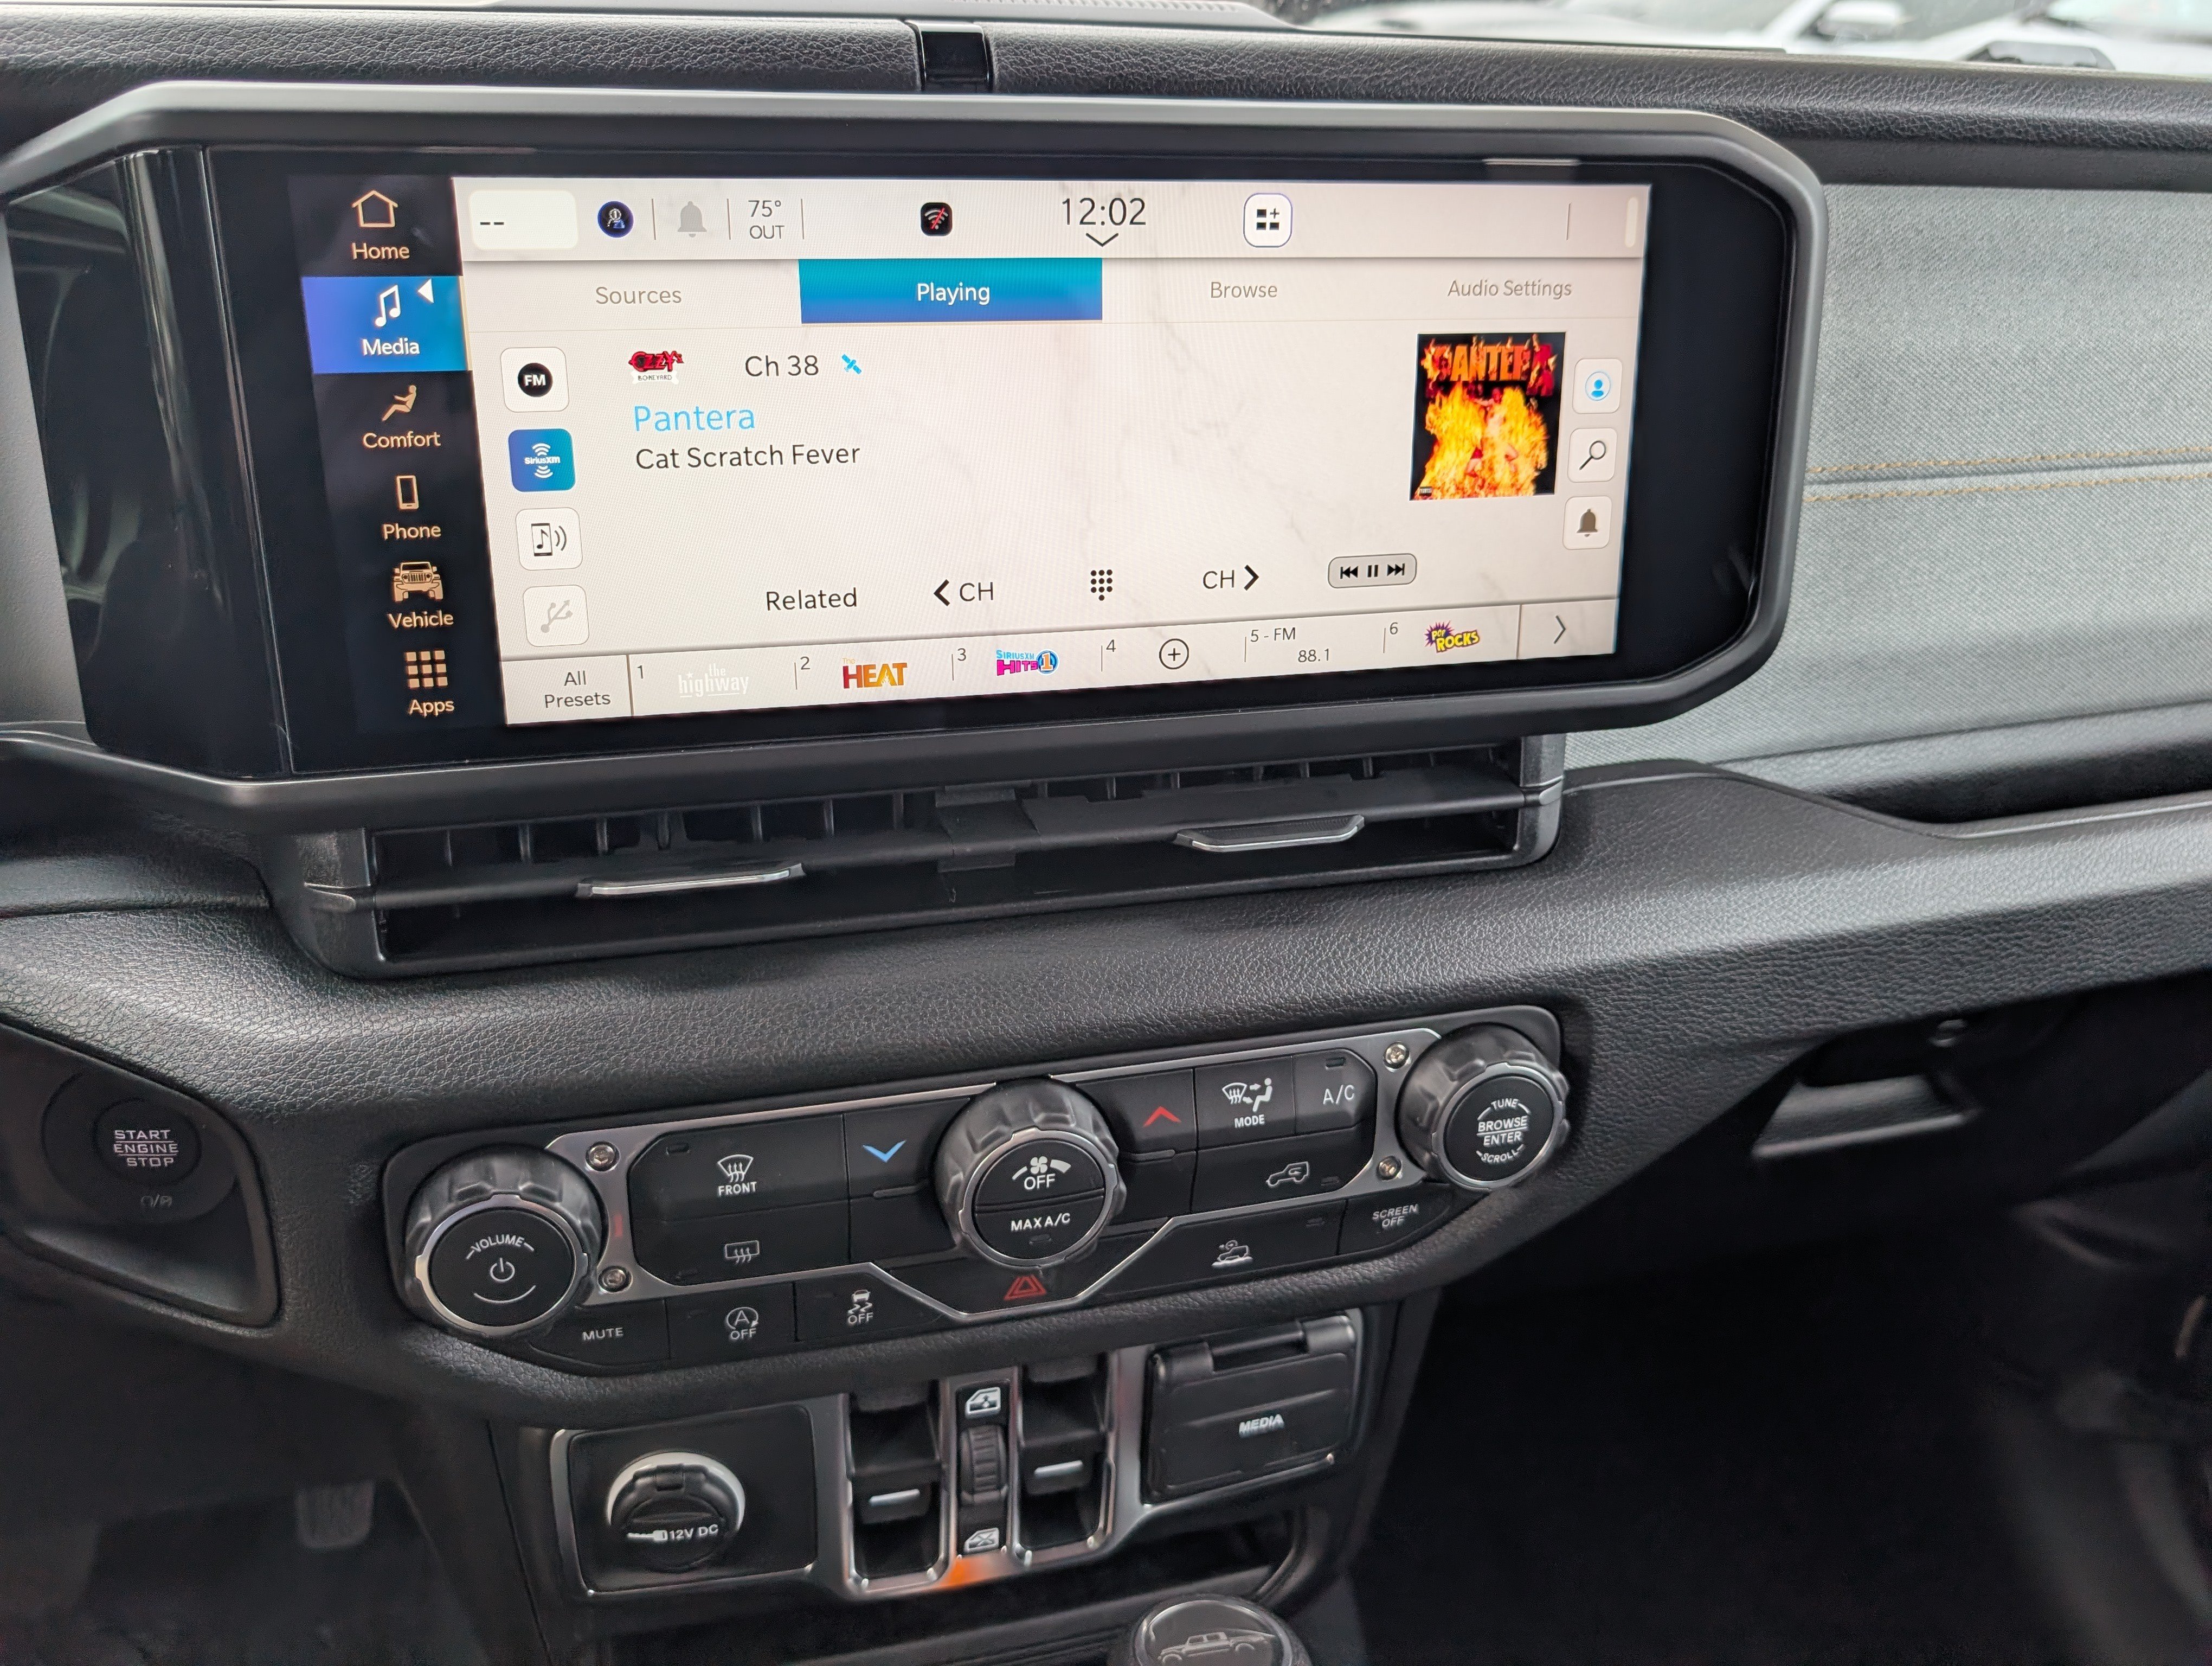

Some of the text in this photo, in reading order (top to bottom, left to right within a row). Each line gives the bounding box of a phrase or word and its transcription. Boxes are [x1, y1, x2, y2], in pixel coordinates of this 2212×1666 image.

[1061, 197, 1147, 226] 12:02
[749, 225, 785, 240] OUT
[351, 242, 410, 260] Home
[595, 286, 683, 305] Sources
[916, 282, 991, 305] Playing
[1210, 281, 1278, 299] Browse
[1447, 278, 1572, 300] Audio Settings
[362, 338, 420, 356] Media
[745, 356, 819, 376] Ch 38
[524, 374, 546, 387] FM
[634, 406, 756, 432] Pantera
[363, 431, 441, 449] Comfort
[636, 444, 861, 469] Cat Scratch Fever
[382, 523, 442, 540] Phone
[1203, 569, 1235, 589] CH
[766, 587, 858, 611] Related
[959, 581, 994, 602] CH
[387, 610, 454, 629] Vehicle
[1250, 630, 1259, 642] 5
[1273, 627, 1296, 641] FM
[1389, 622, 1398, 635] 6
[1105, 639, 1116, 652] 4
[1436, 631, 1480, 652] ROCKS
[957, 648, 967, 661] 3
[1297, 648, 1330, 663] 88.1
[709, 663, 726, 677] the
[800, 657, 811, 670] 2
[996, 653, 1053, 676] HITS 1
[564, 670, 588, 686] All
[637, 665, 645, 680] 1
[843, 662, 908, 689] HEAT
[678, 671, 749, 697] highway
[408, 699, 455, 717] Apps
[545, 691, 612, 708] Presets
[1322, 1084, 1355, 1105] A/C
[1491, 1098, 1519, 1110] TUNE
[1234, 1114, 1265, 1129] MODE
[1478, 1115, 1527, 1131] BROWSE
[114, 1129, 171, 1139] START
[1483, 1131, 1523, 1146] ENTER
[113, 1143, 179, 1153] ENGINE
[1480, 1149, 1519, 1163] SCROLL
[126, 1157, 175, 1167] STOP
[717, 1181, 757, 1196] FRONT
[1024, 1173, 1056, 1190] OFF
[1372, 1203, 1419, 1220] SCREEN
[1010, 1213, 1071, 1232] MAX A/C
[1381, 1216, 1404, 1228] OFF
[470, 1234, 525, 1253] VOLUME
[847, 1312, 874, 1325] OFF
[582, 1327, 624, 1340] MUTE
[730, 1327, 757, 1340] OFF
[1238, 1414, 1284, 1436] MEDIA
[669, 1523, 719, 1541] 12V DC
